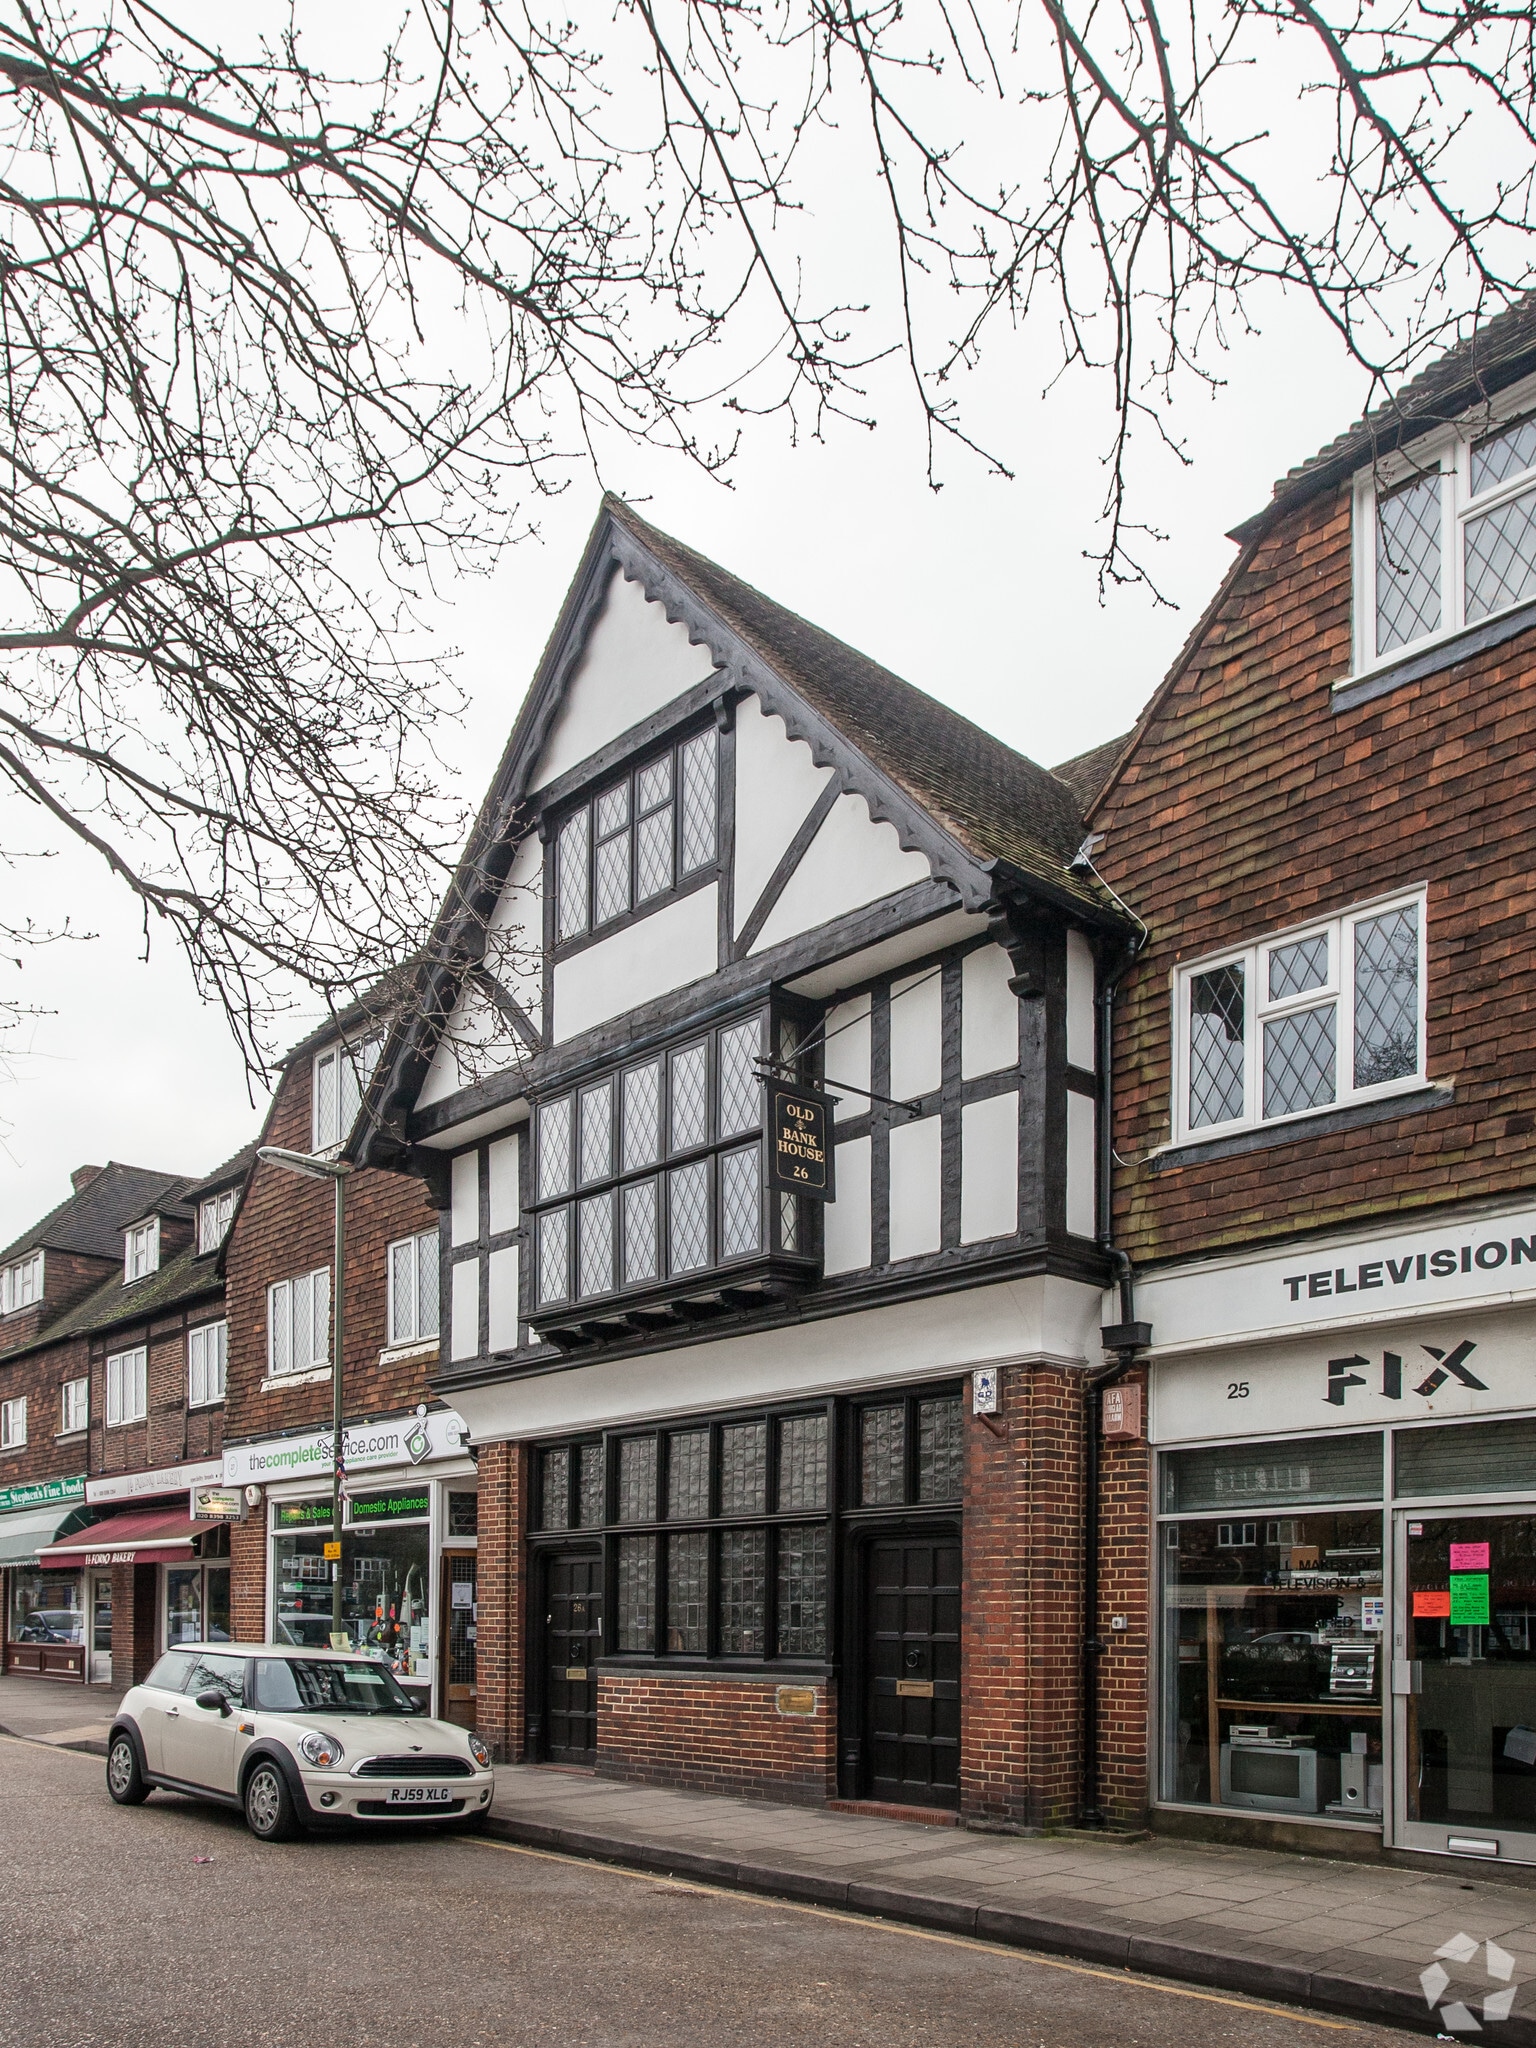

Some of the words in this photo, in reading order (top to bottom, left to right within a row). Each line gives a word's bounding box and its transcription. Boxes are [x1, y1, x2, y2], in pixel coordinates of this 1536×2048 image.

[786, 1104, 814, 1122] OLD
[783, 1128, 817, 1146] BANK
[778, 1140, 824, 1162] HOUSE
[793, 1166, 808, 1180] 26
[1283, 1235, 1536, 1302] TELEVISION
[1321, 1339, 1490, 1406] FIX
[1227, 1382, 1250, 1399] 25
[378, 1452, 398, 1460] provider
[10, 1486, 43, 1504] Stephen's
[43, 1484, 60, 1498] Fine
[61, 1480, 84, 1496] Foods
[306, 1508, 310, 1518] &
[312, 1507, 330, 1518] Sales
[354, 1501, 386, 1514] Domestic
[388, 1498, 428, 1514] Appliances
[111, 1552, 136, 1562] BAKERY
[1300, 1559, 1348, 1570] MAKES
[1272, 1577, 1350, 1590] TELEVISION
[1357, 1577, 1366, 1589] &
[392, 1788, 423, 1800] RJ59
[426, 1788, 448, 1800] XLG
